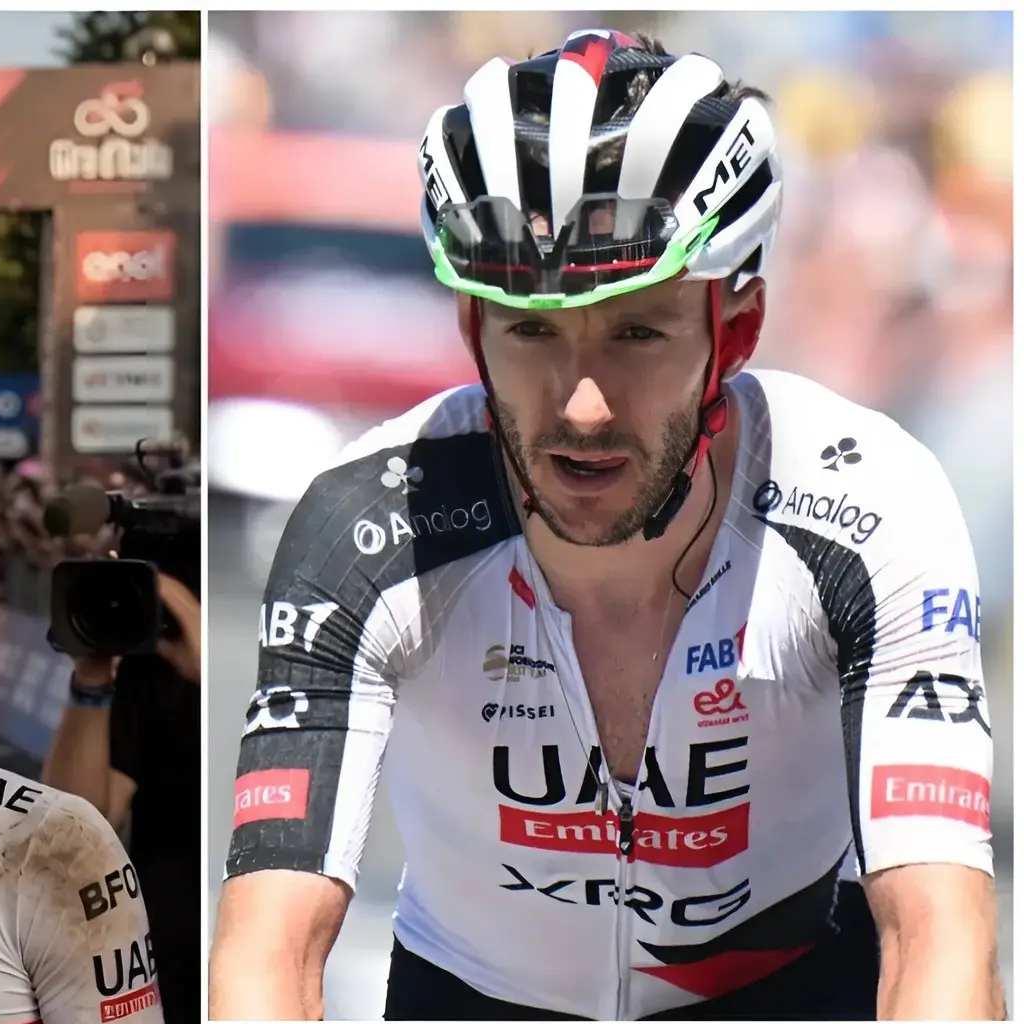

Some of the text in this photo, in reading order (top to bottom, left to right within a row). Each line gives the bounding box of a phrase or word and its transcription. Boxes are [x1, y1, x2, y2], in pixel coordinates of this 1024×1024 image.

[418, 136, 450, 204] ME
[694, 119, 755, 216] MET
[783, 486, 883, 545] Analog
[493, 736, 751, 808] UAE
[498, 863, 752, 927] XRG
